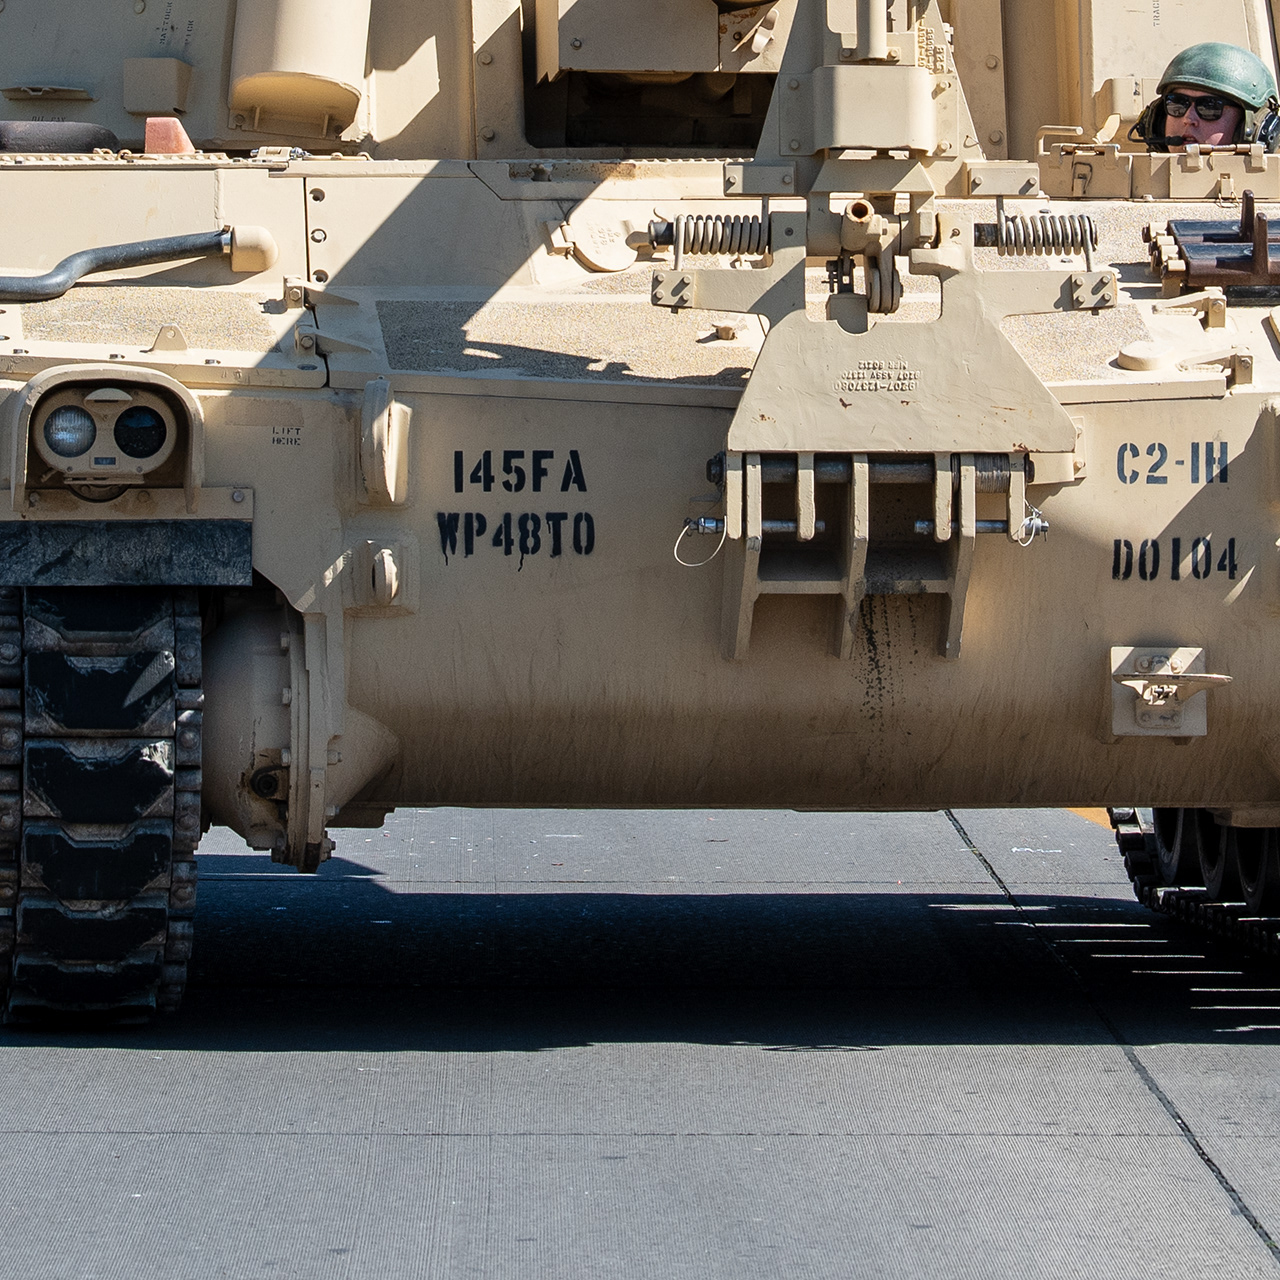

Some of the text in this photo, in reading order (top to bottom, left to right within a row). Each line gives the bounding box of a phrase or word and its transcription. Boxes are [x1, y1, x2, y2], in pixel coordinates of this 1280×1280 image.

[160, 1, 173, 45] MATTOCK
[272, 427, 301, 435] LIFT
[272, 437, 301, 445] HERE
